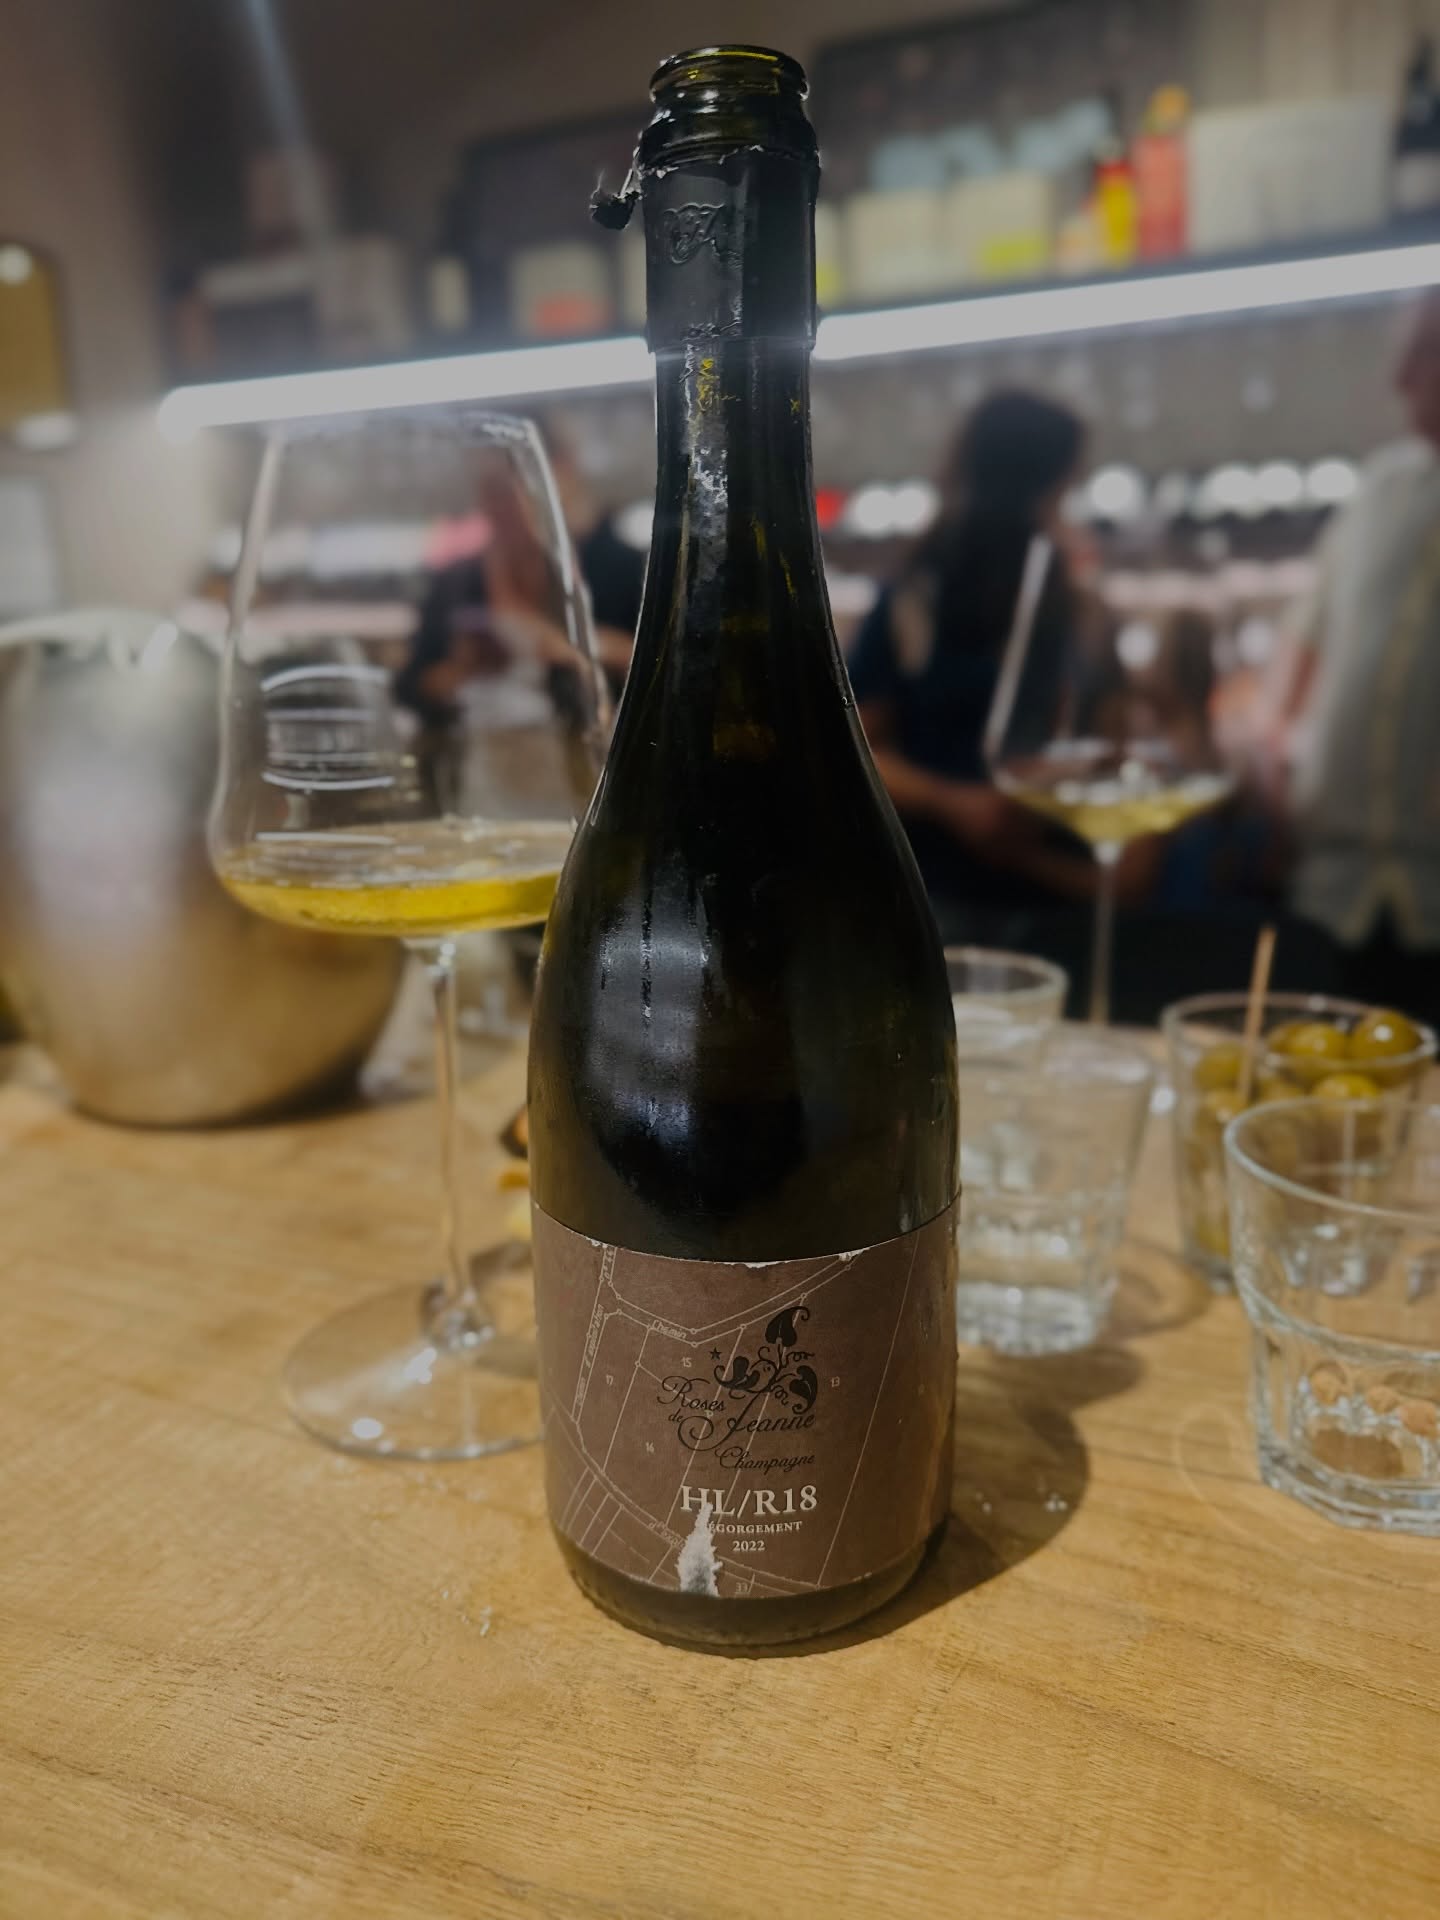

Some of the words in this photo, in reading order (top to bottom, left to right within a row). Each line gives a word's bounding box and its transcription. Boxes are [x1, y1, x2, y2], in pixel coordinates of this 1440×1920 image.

[656, 1375, 727, 1412] Roses
[668, 1408, 684, 1424] de
[714, 1445, 816, 1475] Champagne
[680, 1484, 818, 1519] HL/R18
[708, 1520, 803, 1534] ÉGORGEMENT
[732, 1540, 766, 1552] 2022
